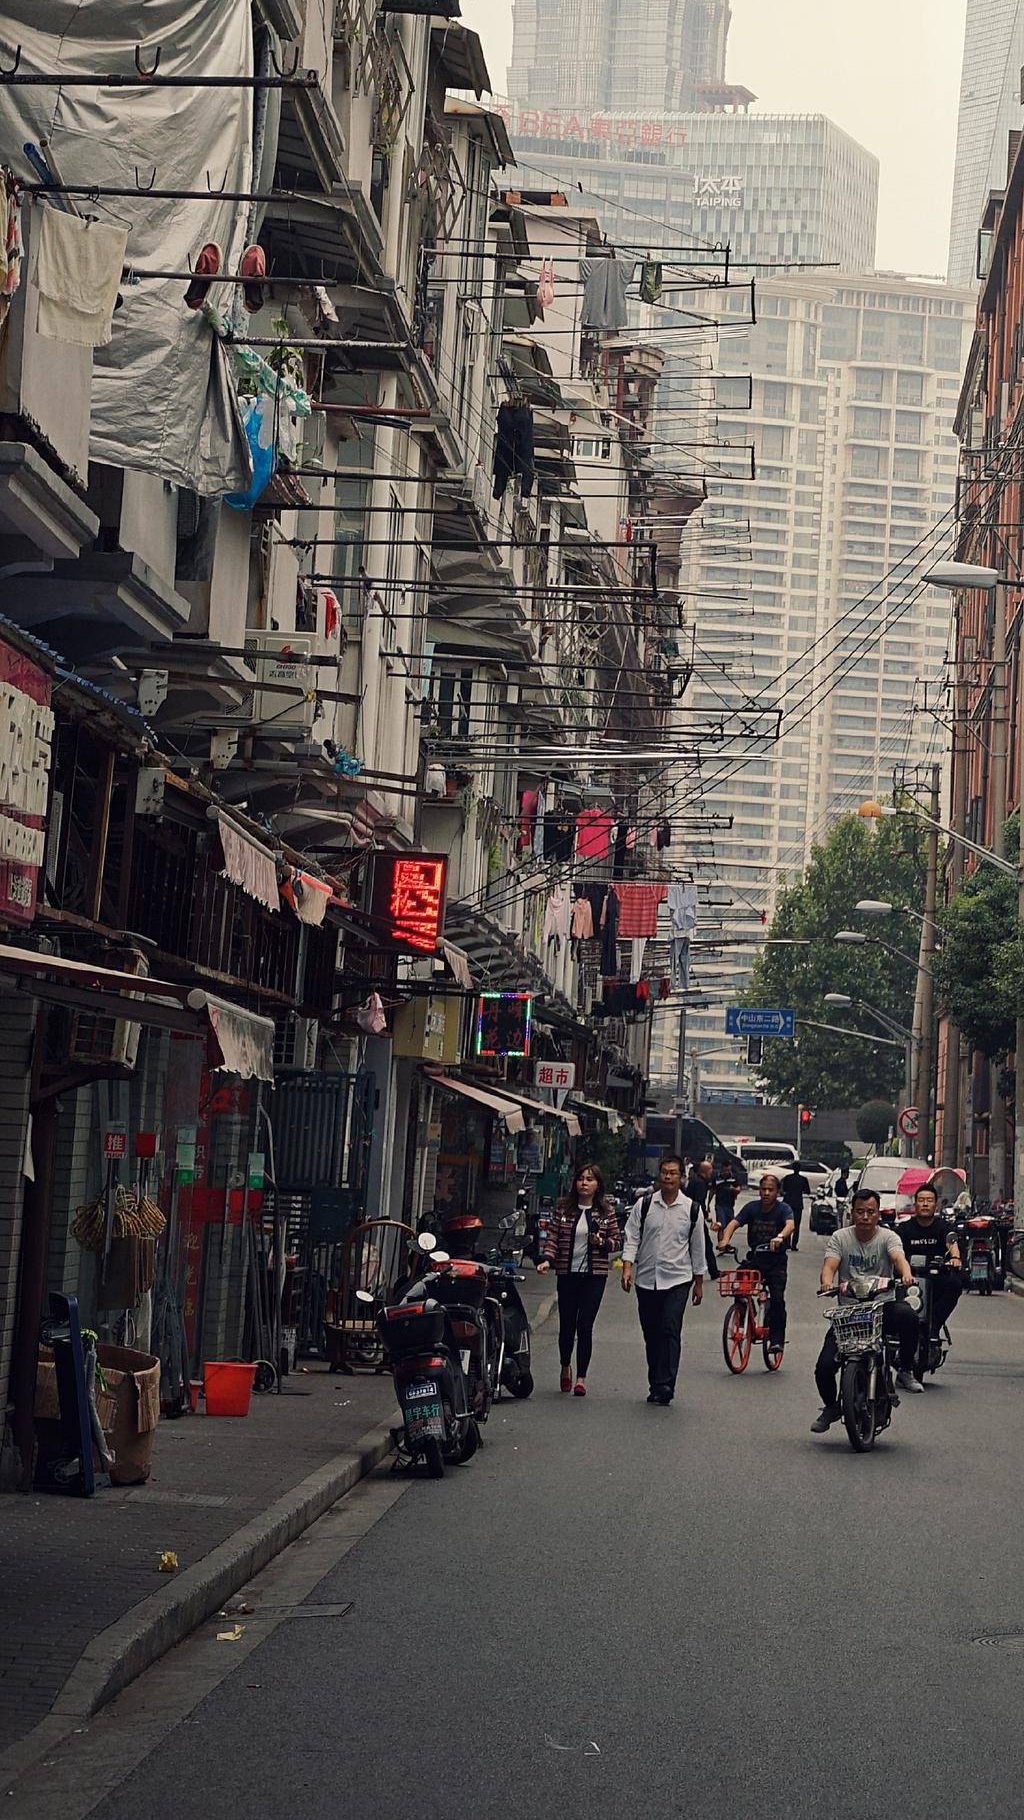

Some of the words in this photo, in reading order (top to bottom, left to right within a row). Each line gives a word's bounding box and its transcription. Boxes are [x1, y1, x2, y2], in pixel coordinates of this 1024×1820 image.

[518, 111, 584, 140] BEA
[590, 116, 688, 148] 東亞銀行
[695, 197, 742, 208] TAIPING
[538, 1066, 569, 1085] 超市
[106, 1134, 124, 1152] 推
